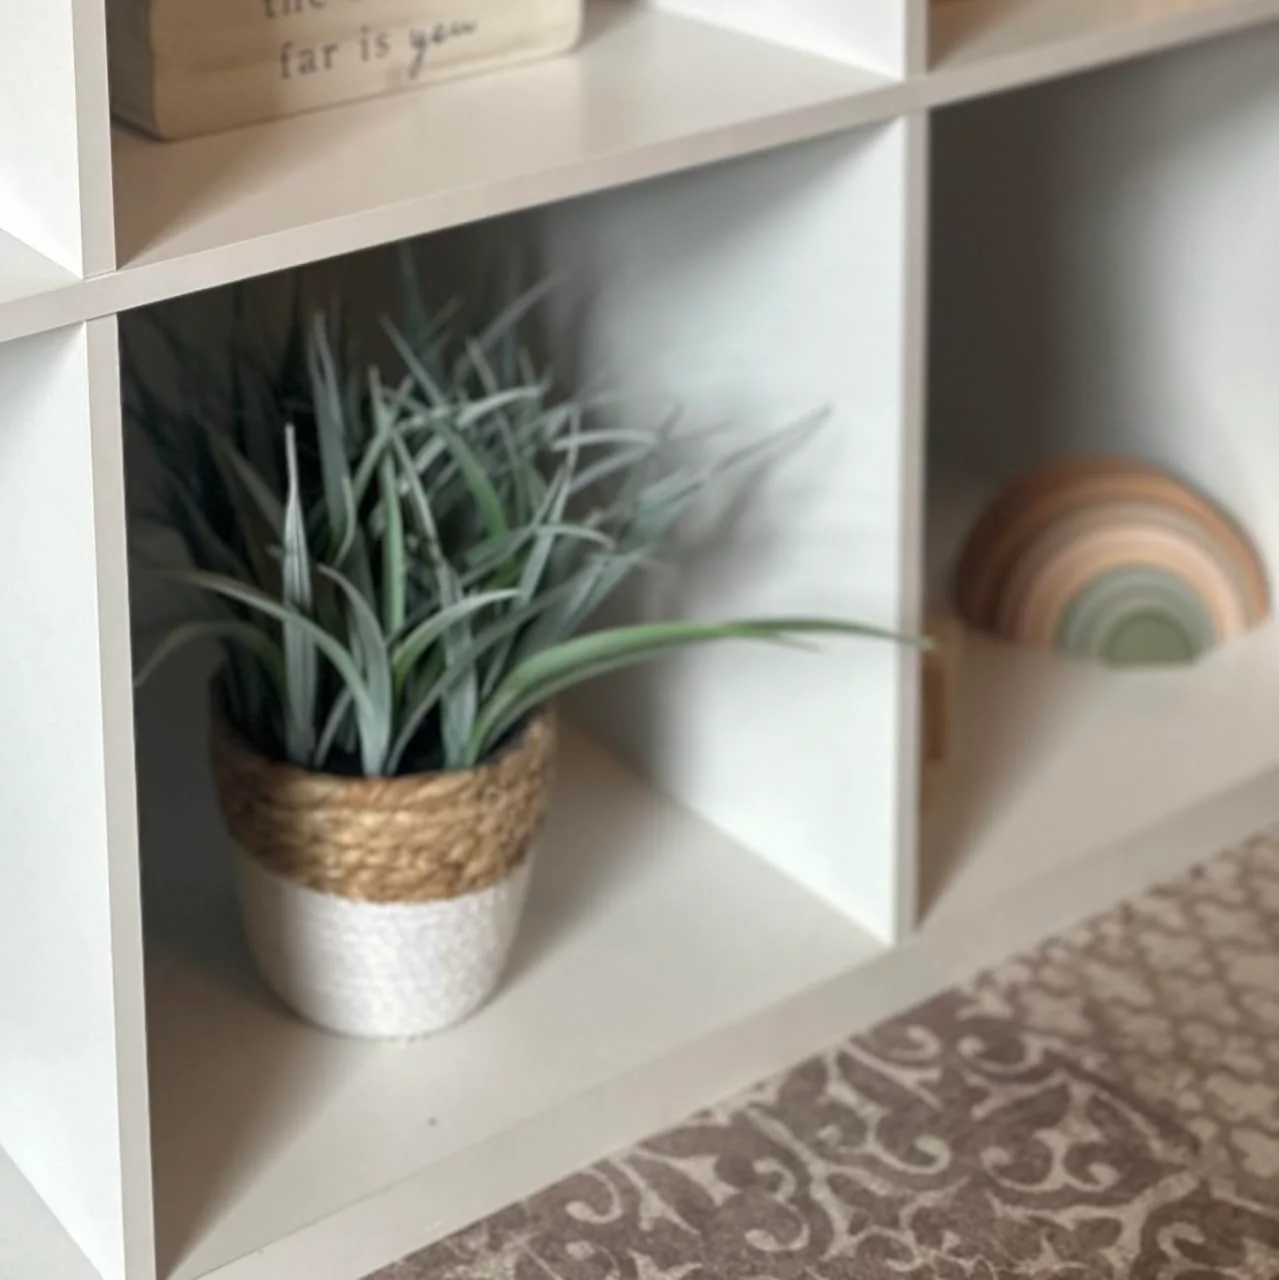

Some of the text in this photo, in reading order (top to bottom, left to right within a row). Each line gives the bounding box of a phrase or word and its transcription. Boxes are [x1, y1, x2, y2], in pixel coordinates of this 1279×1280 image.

[280, 21, 479, 81] far is you
